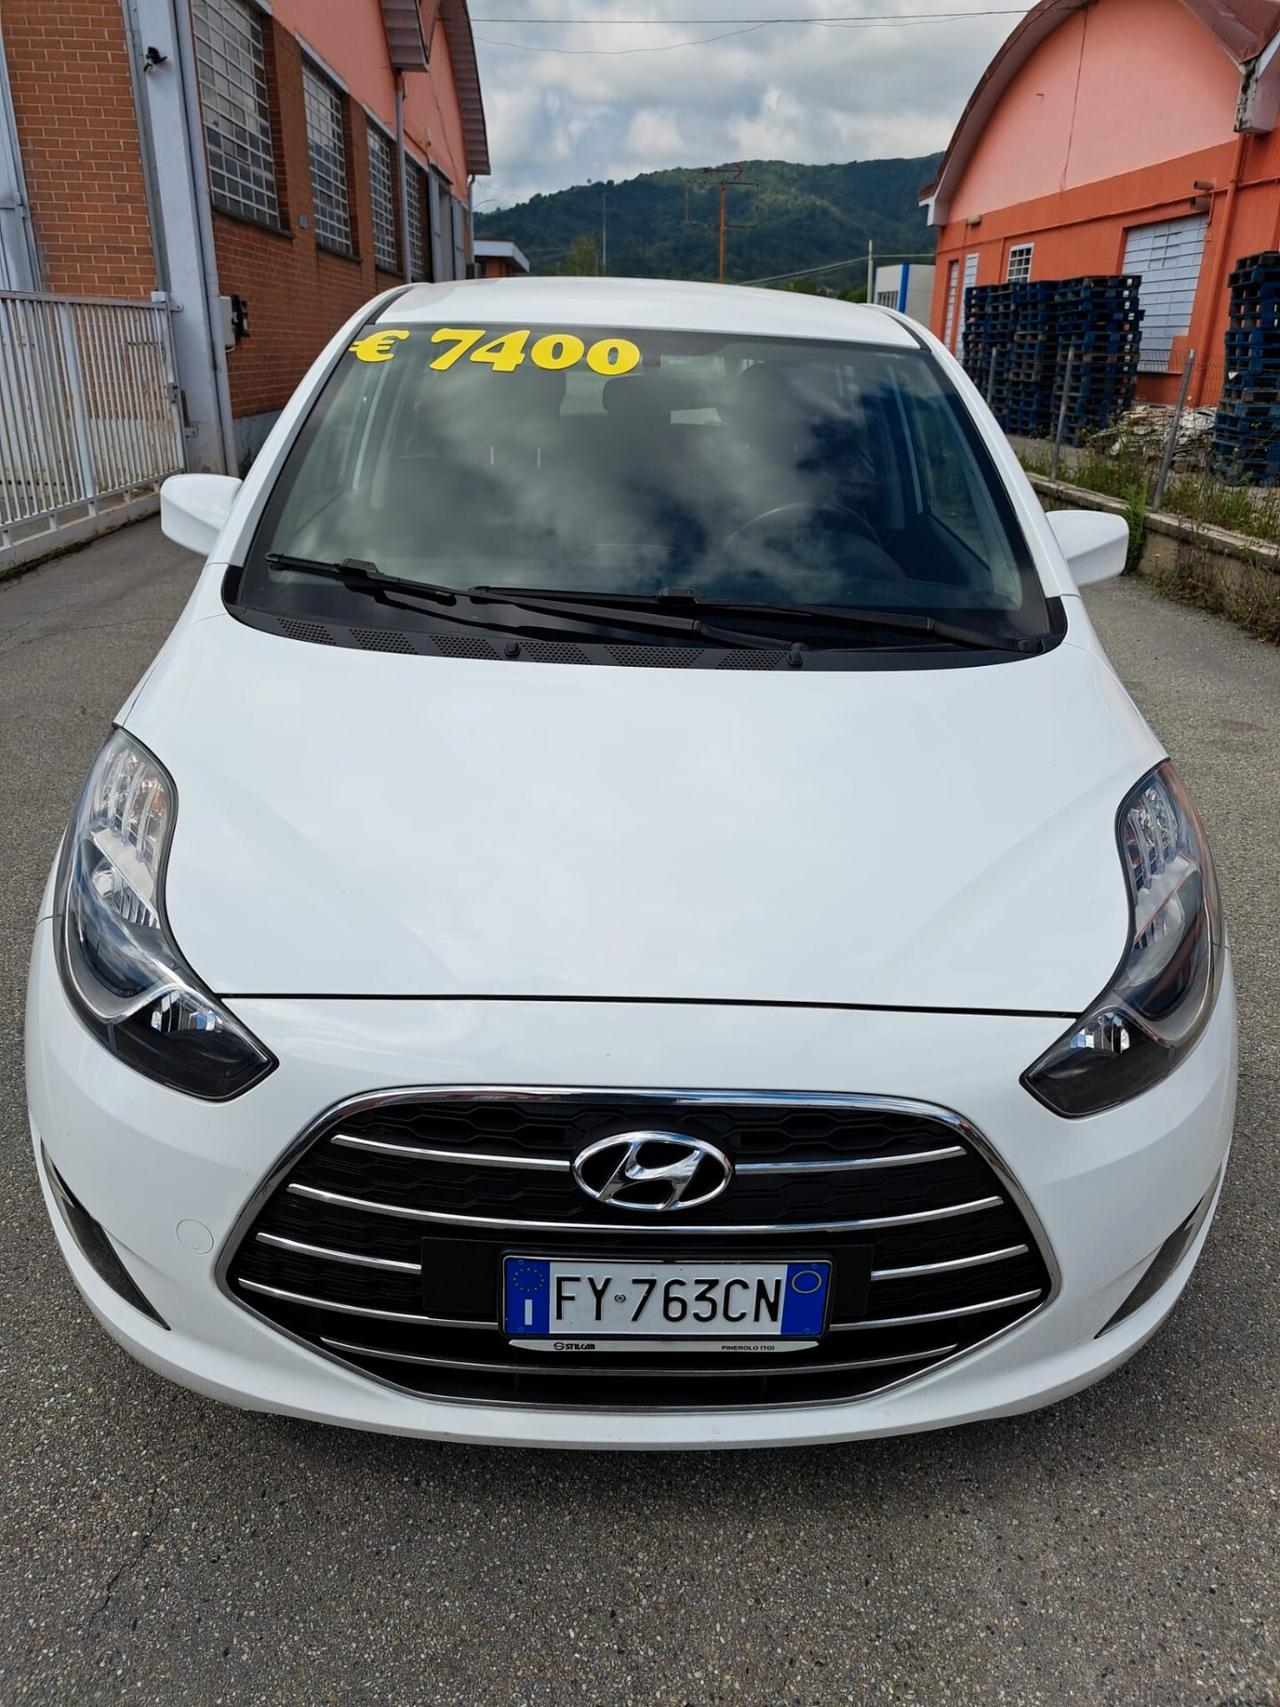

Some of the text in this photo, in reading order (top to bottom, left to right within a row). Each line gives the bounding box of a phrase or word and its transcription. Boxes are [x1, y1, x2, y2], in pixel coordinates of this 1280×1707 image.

[349, 327, 641, 375] € 7400
[554, 1276, 782, 1323] FY 763CN
